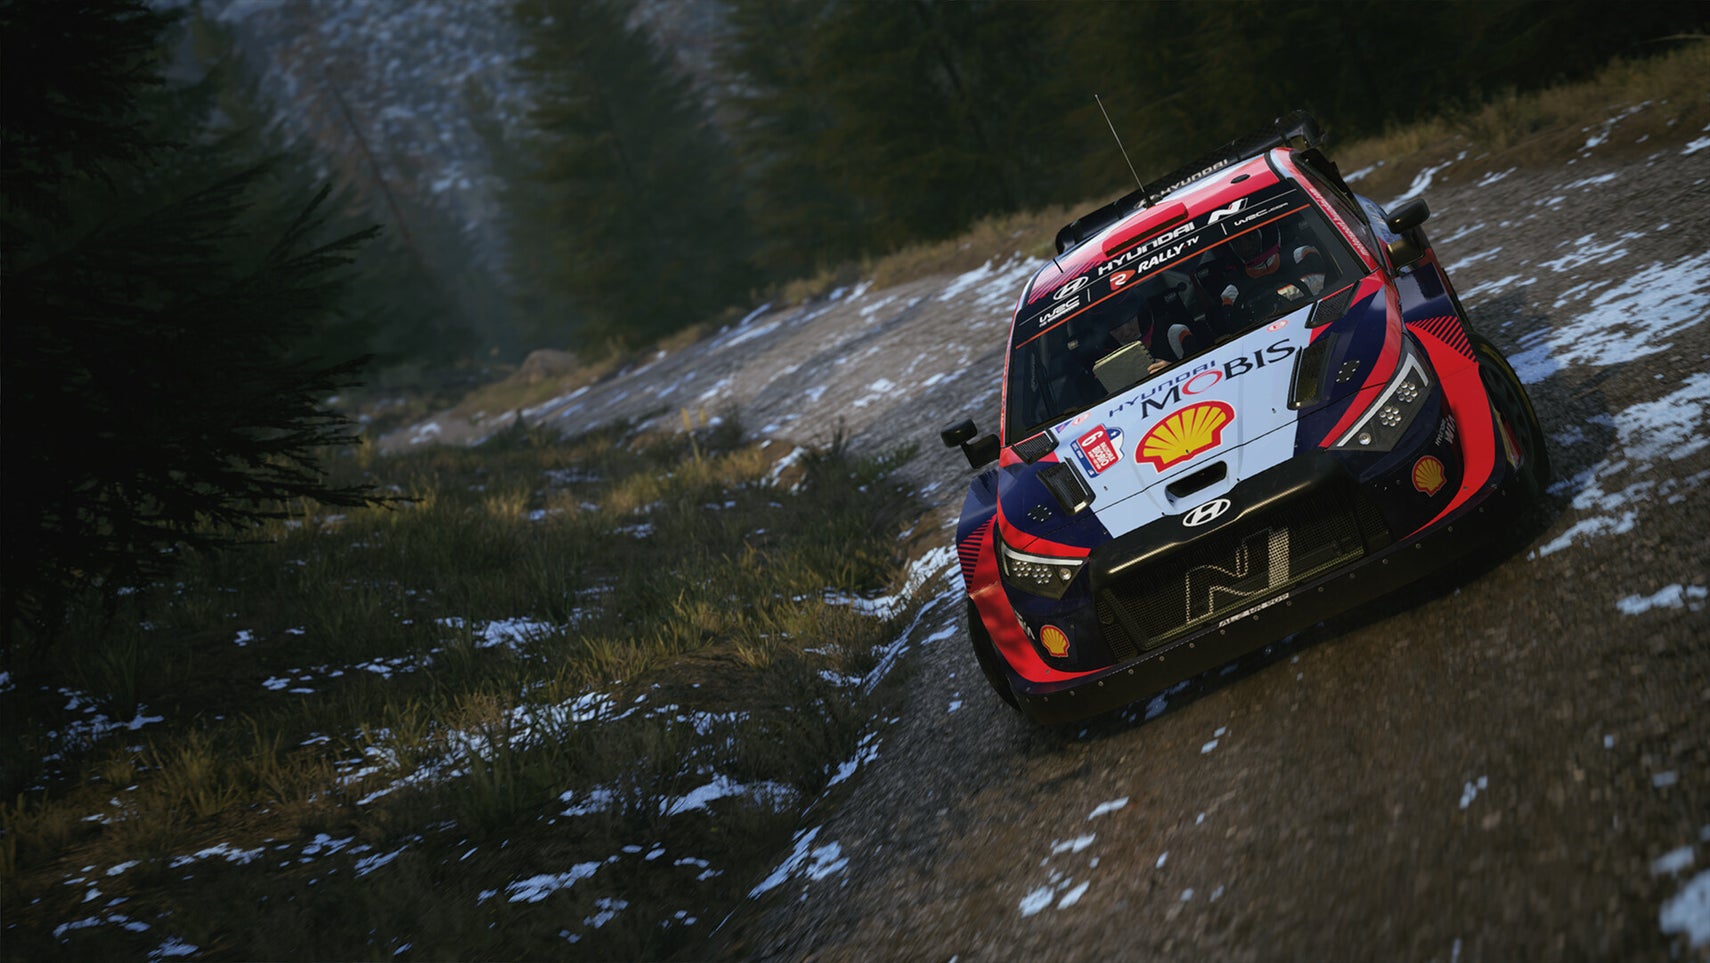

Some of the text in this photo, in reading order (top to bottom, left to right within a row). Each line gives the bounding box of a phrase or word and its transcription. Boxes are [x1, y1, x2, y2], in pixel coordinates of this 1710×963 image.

[1098, 222, 1196, 277] HYUNDAI
[1039, 295, 1081, 324] WRC
[1109, 360, 1217, 418] HYUNDAI
[1141, 338, 1297, 420] MOBIS
[1082, 430, 1104, 447] 6
